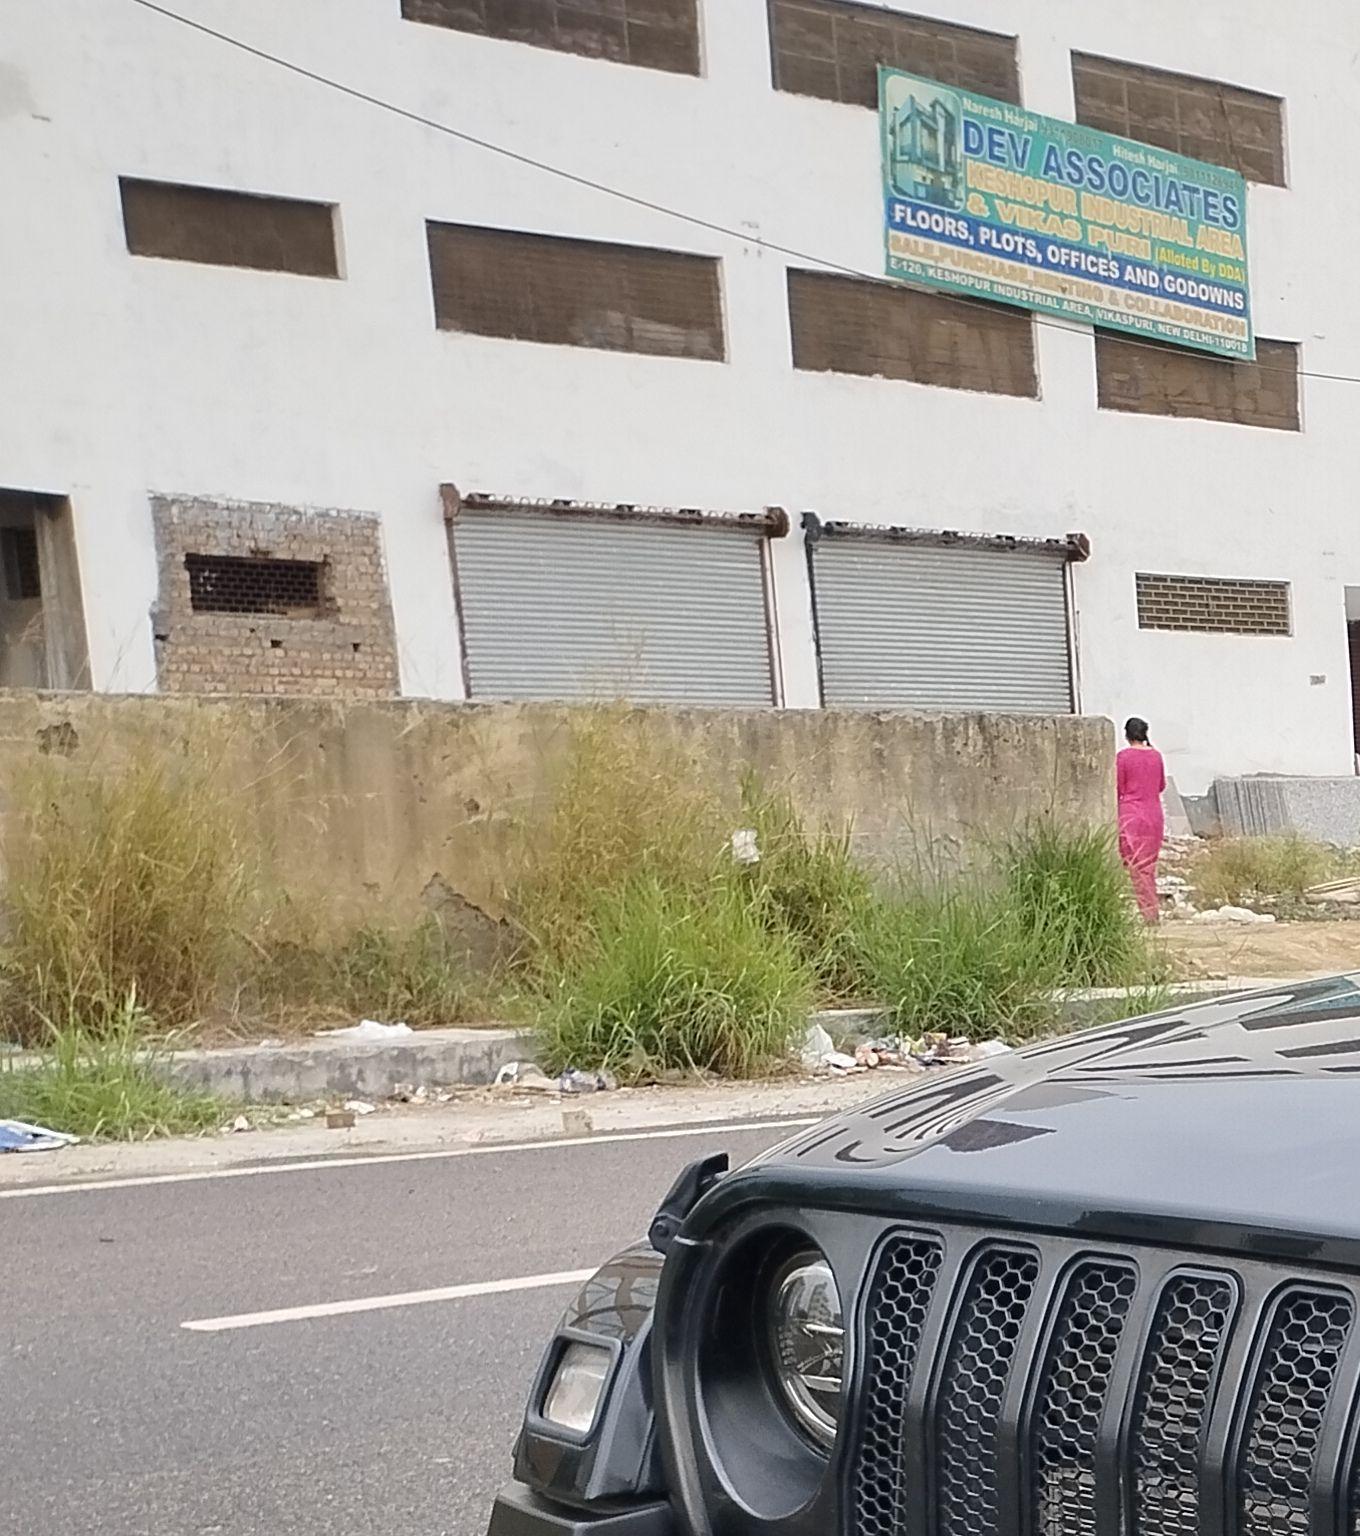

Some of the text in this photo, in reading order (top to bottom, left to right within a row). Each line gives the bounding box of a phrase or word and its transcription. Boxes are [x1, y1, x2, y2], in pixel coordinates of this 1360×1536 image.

[962, 117, 1032, 171] DEV
[1041, 142, 1240, 231] ASSOCIATES
[967, 159, 1245, 261] KESHOPUR INDUSTRIAL AREA
[894, 203, 1245, 310] FLOORS, PLOTS, OFFICES AND GODOWNS
[967, 192, 1246, 285] & VIKAS PURI (Alloted By DDA)
[928, 267, 992, 291] KESHOPUR
[993, 284, 1060, 309] INDUSTRIAL
[1062, 301, 1094, 318] AREA,
[1158, 324, 1181, 338] NEW
[1124, 294, 1246, 337] COLLABORATION
